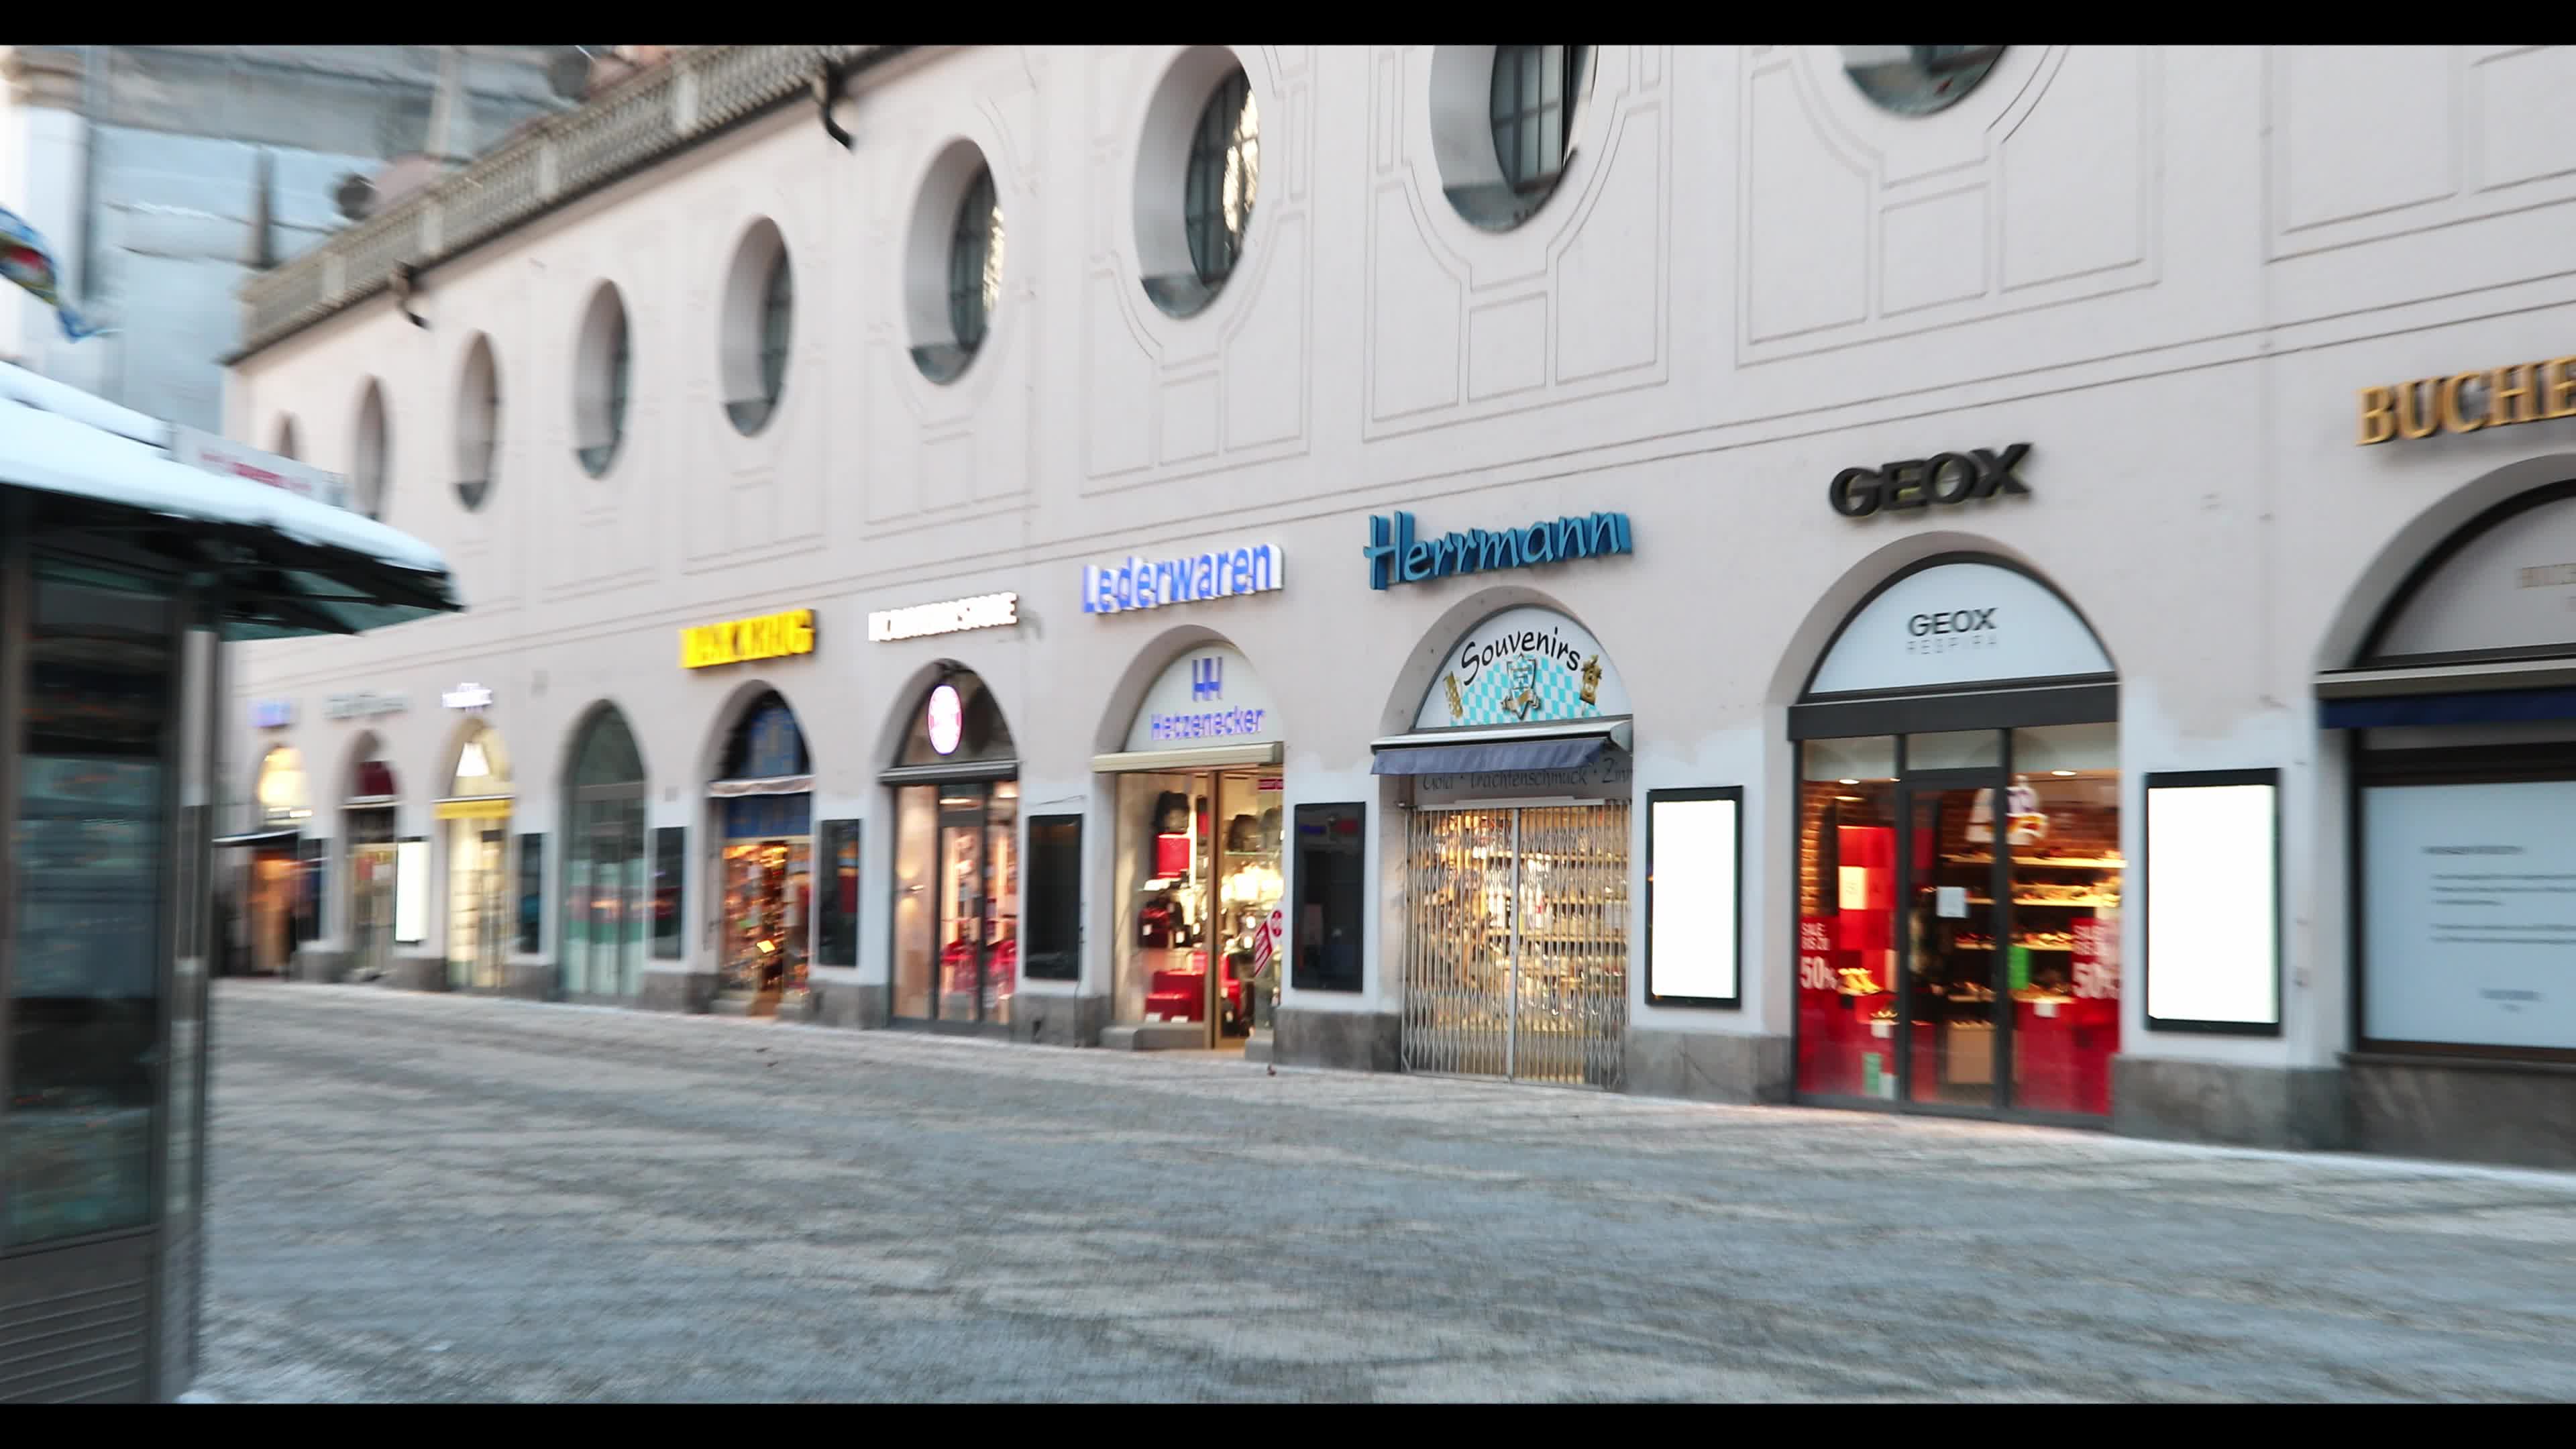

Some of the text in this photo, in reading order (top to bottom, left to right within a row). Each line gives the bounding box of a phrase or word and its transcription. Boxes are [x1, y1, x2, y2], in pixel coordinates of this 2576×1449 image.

[1829, 443, 2033, 517] GEOX
[1082, 543, 1283, 614] Lederwaren
[1363, 510, 1633, 590] Herrmann
[1907, 606, 1998, 637] GEOX
[1907, 635, 1997, 655] RESPRA
[1461, 627, 1580, 686] Souvenirs
